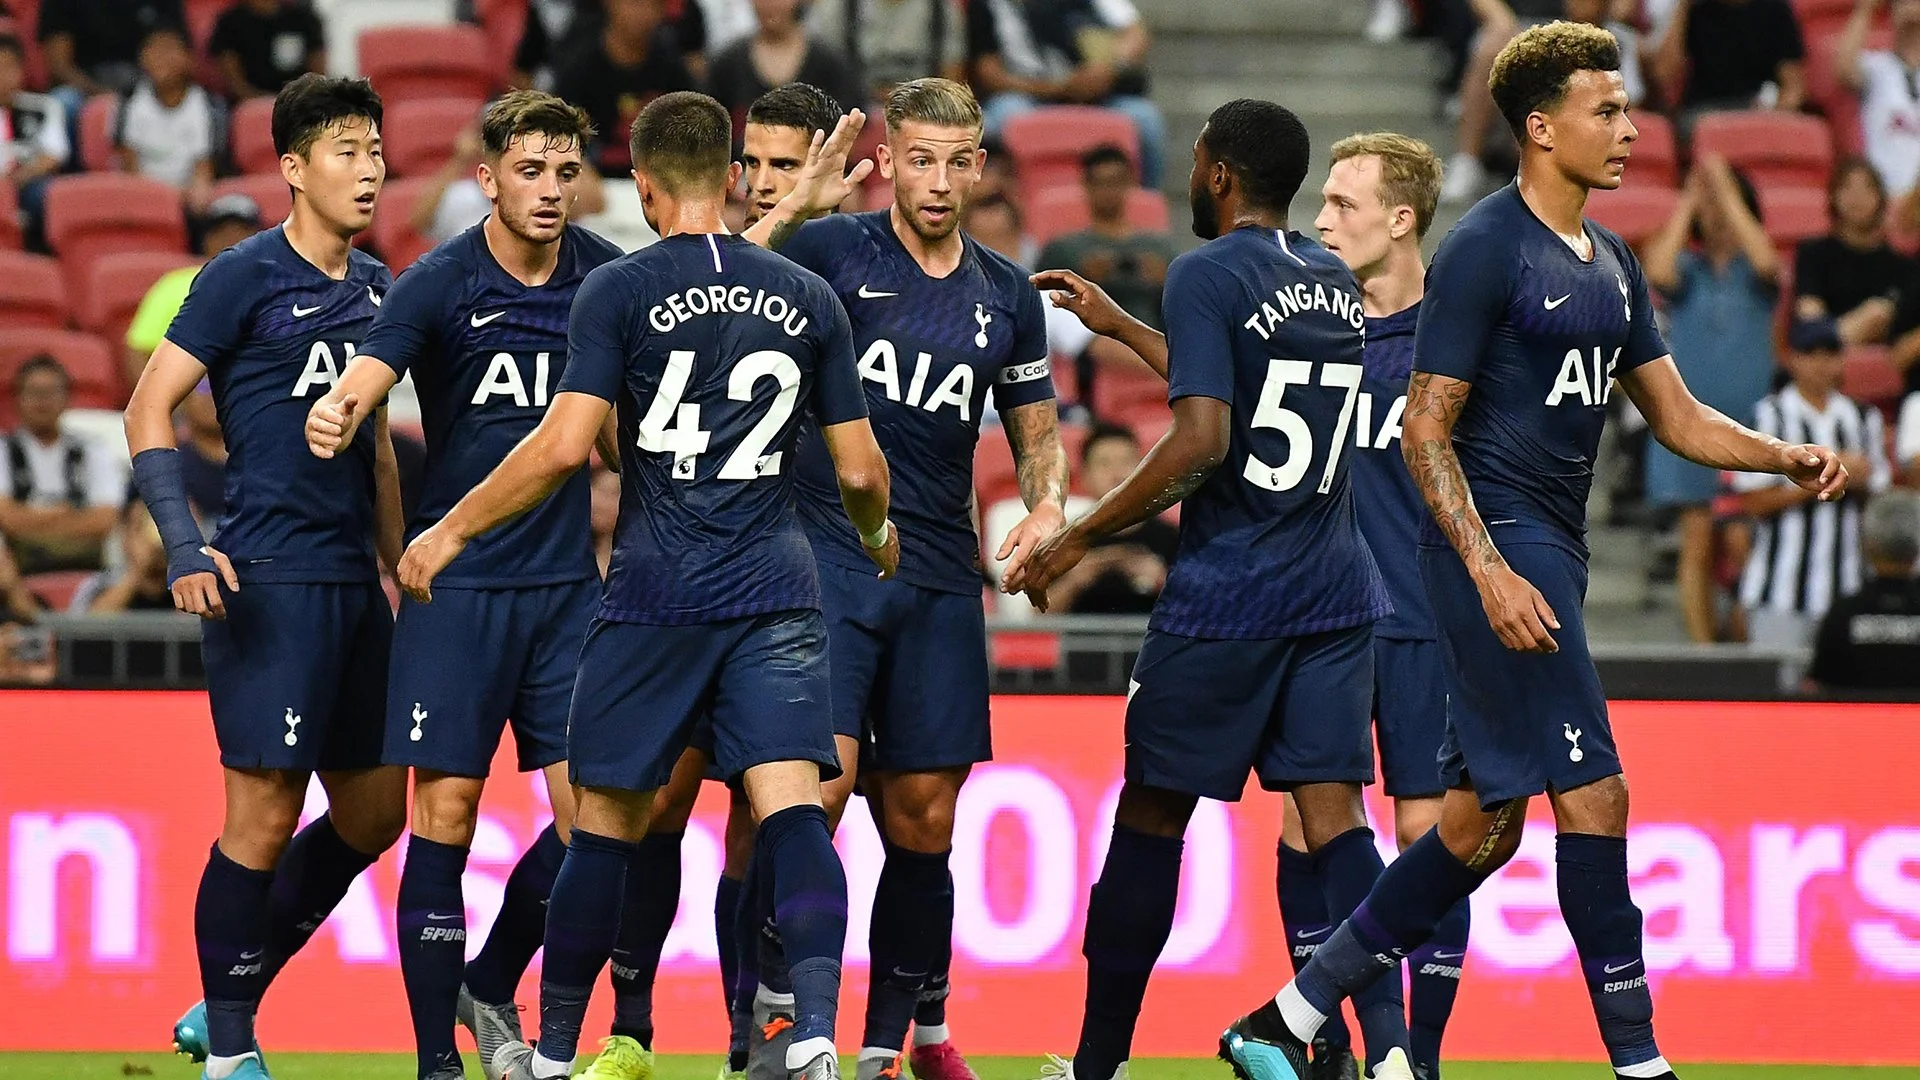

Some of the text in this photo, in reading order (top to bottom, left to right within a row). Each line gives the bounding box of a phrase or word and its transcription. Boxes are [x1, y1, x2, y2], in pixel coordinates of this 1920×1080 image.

[649, 285, 809, 337] GEORGIOU
[636, 350, 802, 480] 42
[857, 338, 974, 421] AIA
[1243, 358, 1364, 495] 57
